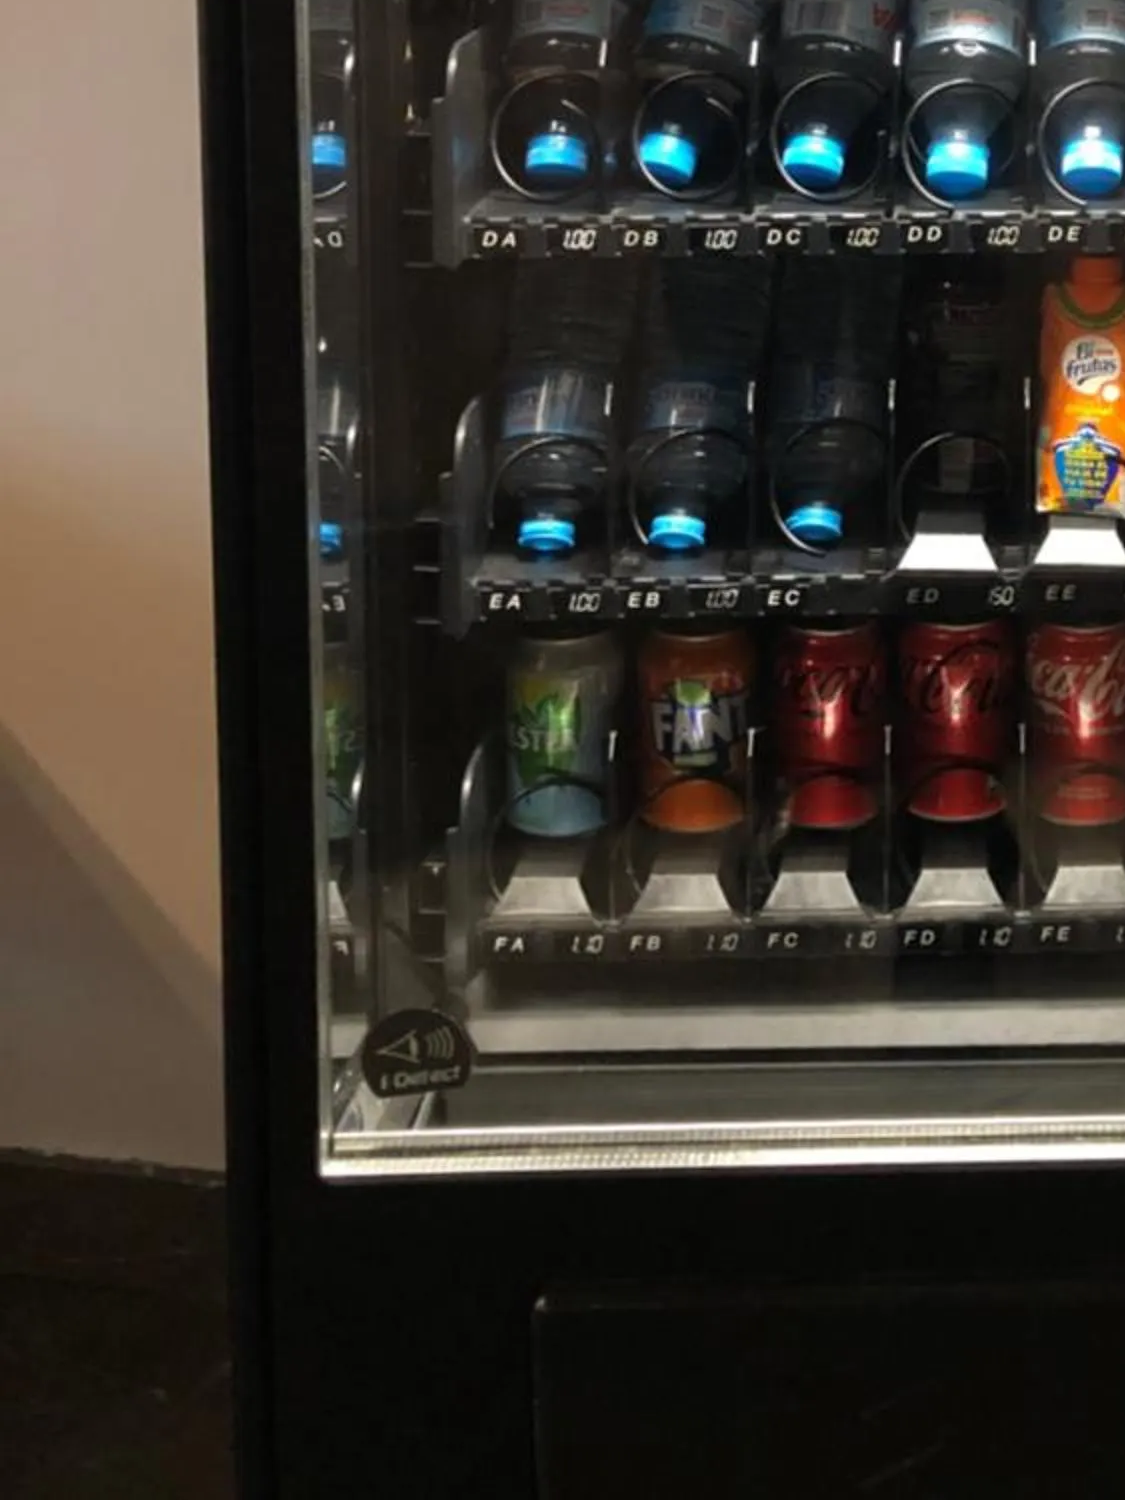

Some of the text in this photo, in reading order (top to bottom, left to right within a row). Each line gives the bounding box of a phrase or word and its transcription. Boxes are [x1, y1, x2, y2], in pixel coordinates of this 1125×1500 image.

[482, 230, 516, 247] DA
[623, 230, 658, 247] DB
[766, 228, 801, 245] DC
[907, 225, 942, 243] DD
[1047, 225, 1081, 242] DE
[489, 593, 521, 609] EA
[627, 591, 660, 608] EB
[767, 589, 800, 606] EC
[650, 694, 750, 754] FANT
[767, 932, 798, 948] FC
[903, 929, 935, 946] FD
[1040, 925, 1071, 942] FE
[494, 936, 524, 951] FA
[630, 935, 661, 951] FB
